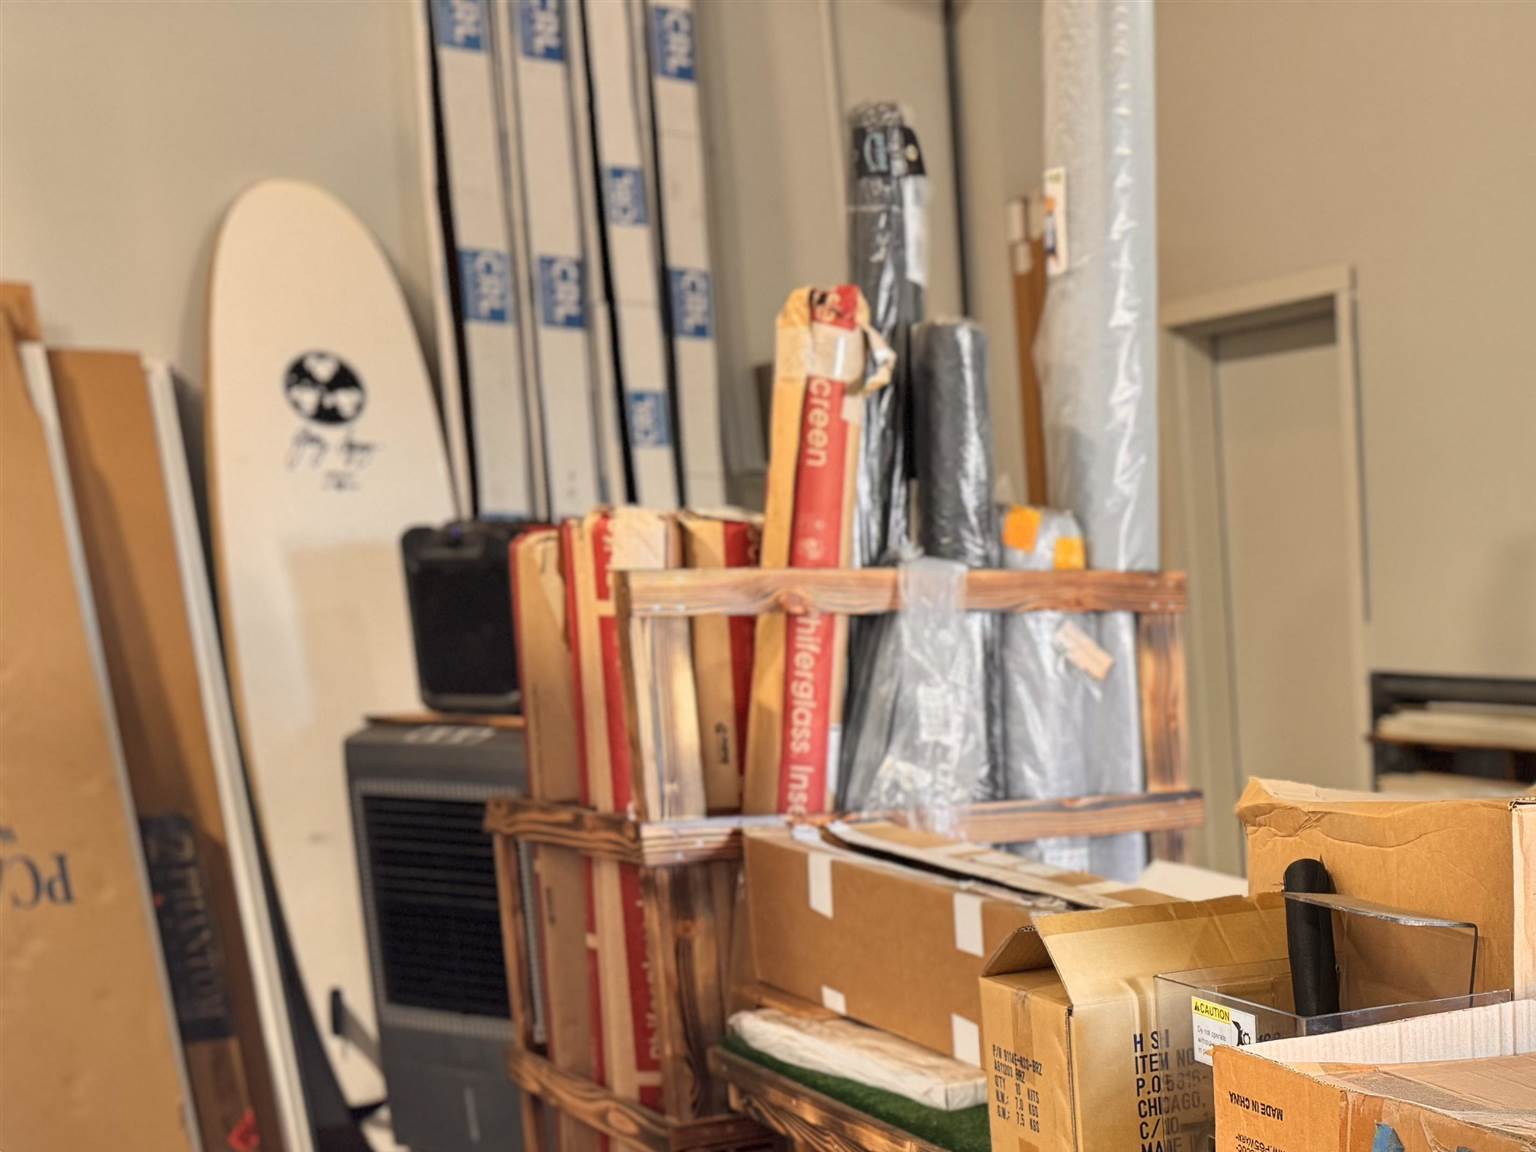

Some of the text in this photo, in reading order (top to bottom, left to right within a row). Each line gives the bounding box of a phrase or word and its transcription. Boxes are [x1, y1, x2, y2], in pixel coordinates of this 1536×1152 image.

[664, 11, 694, 73] CRL
[475, 253, 504, 319] CRL
[552, 261, 582, 325] CRL
[681, 272, 708, 331] CRL
[804, 378, 830, 467] creen
[788, 608, 822, 754] hiferglass
[1200, 1003, 1230, 1021] CAUTION
[1135, 1052, 1168, 1074] ITEM
[1229, 1091, 1283, 1121] MADE IN CHINA
